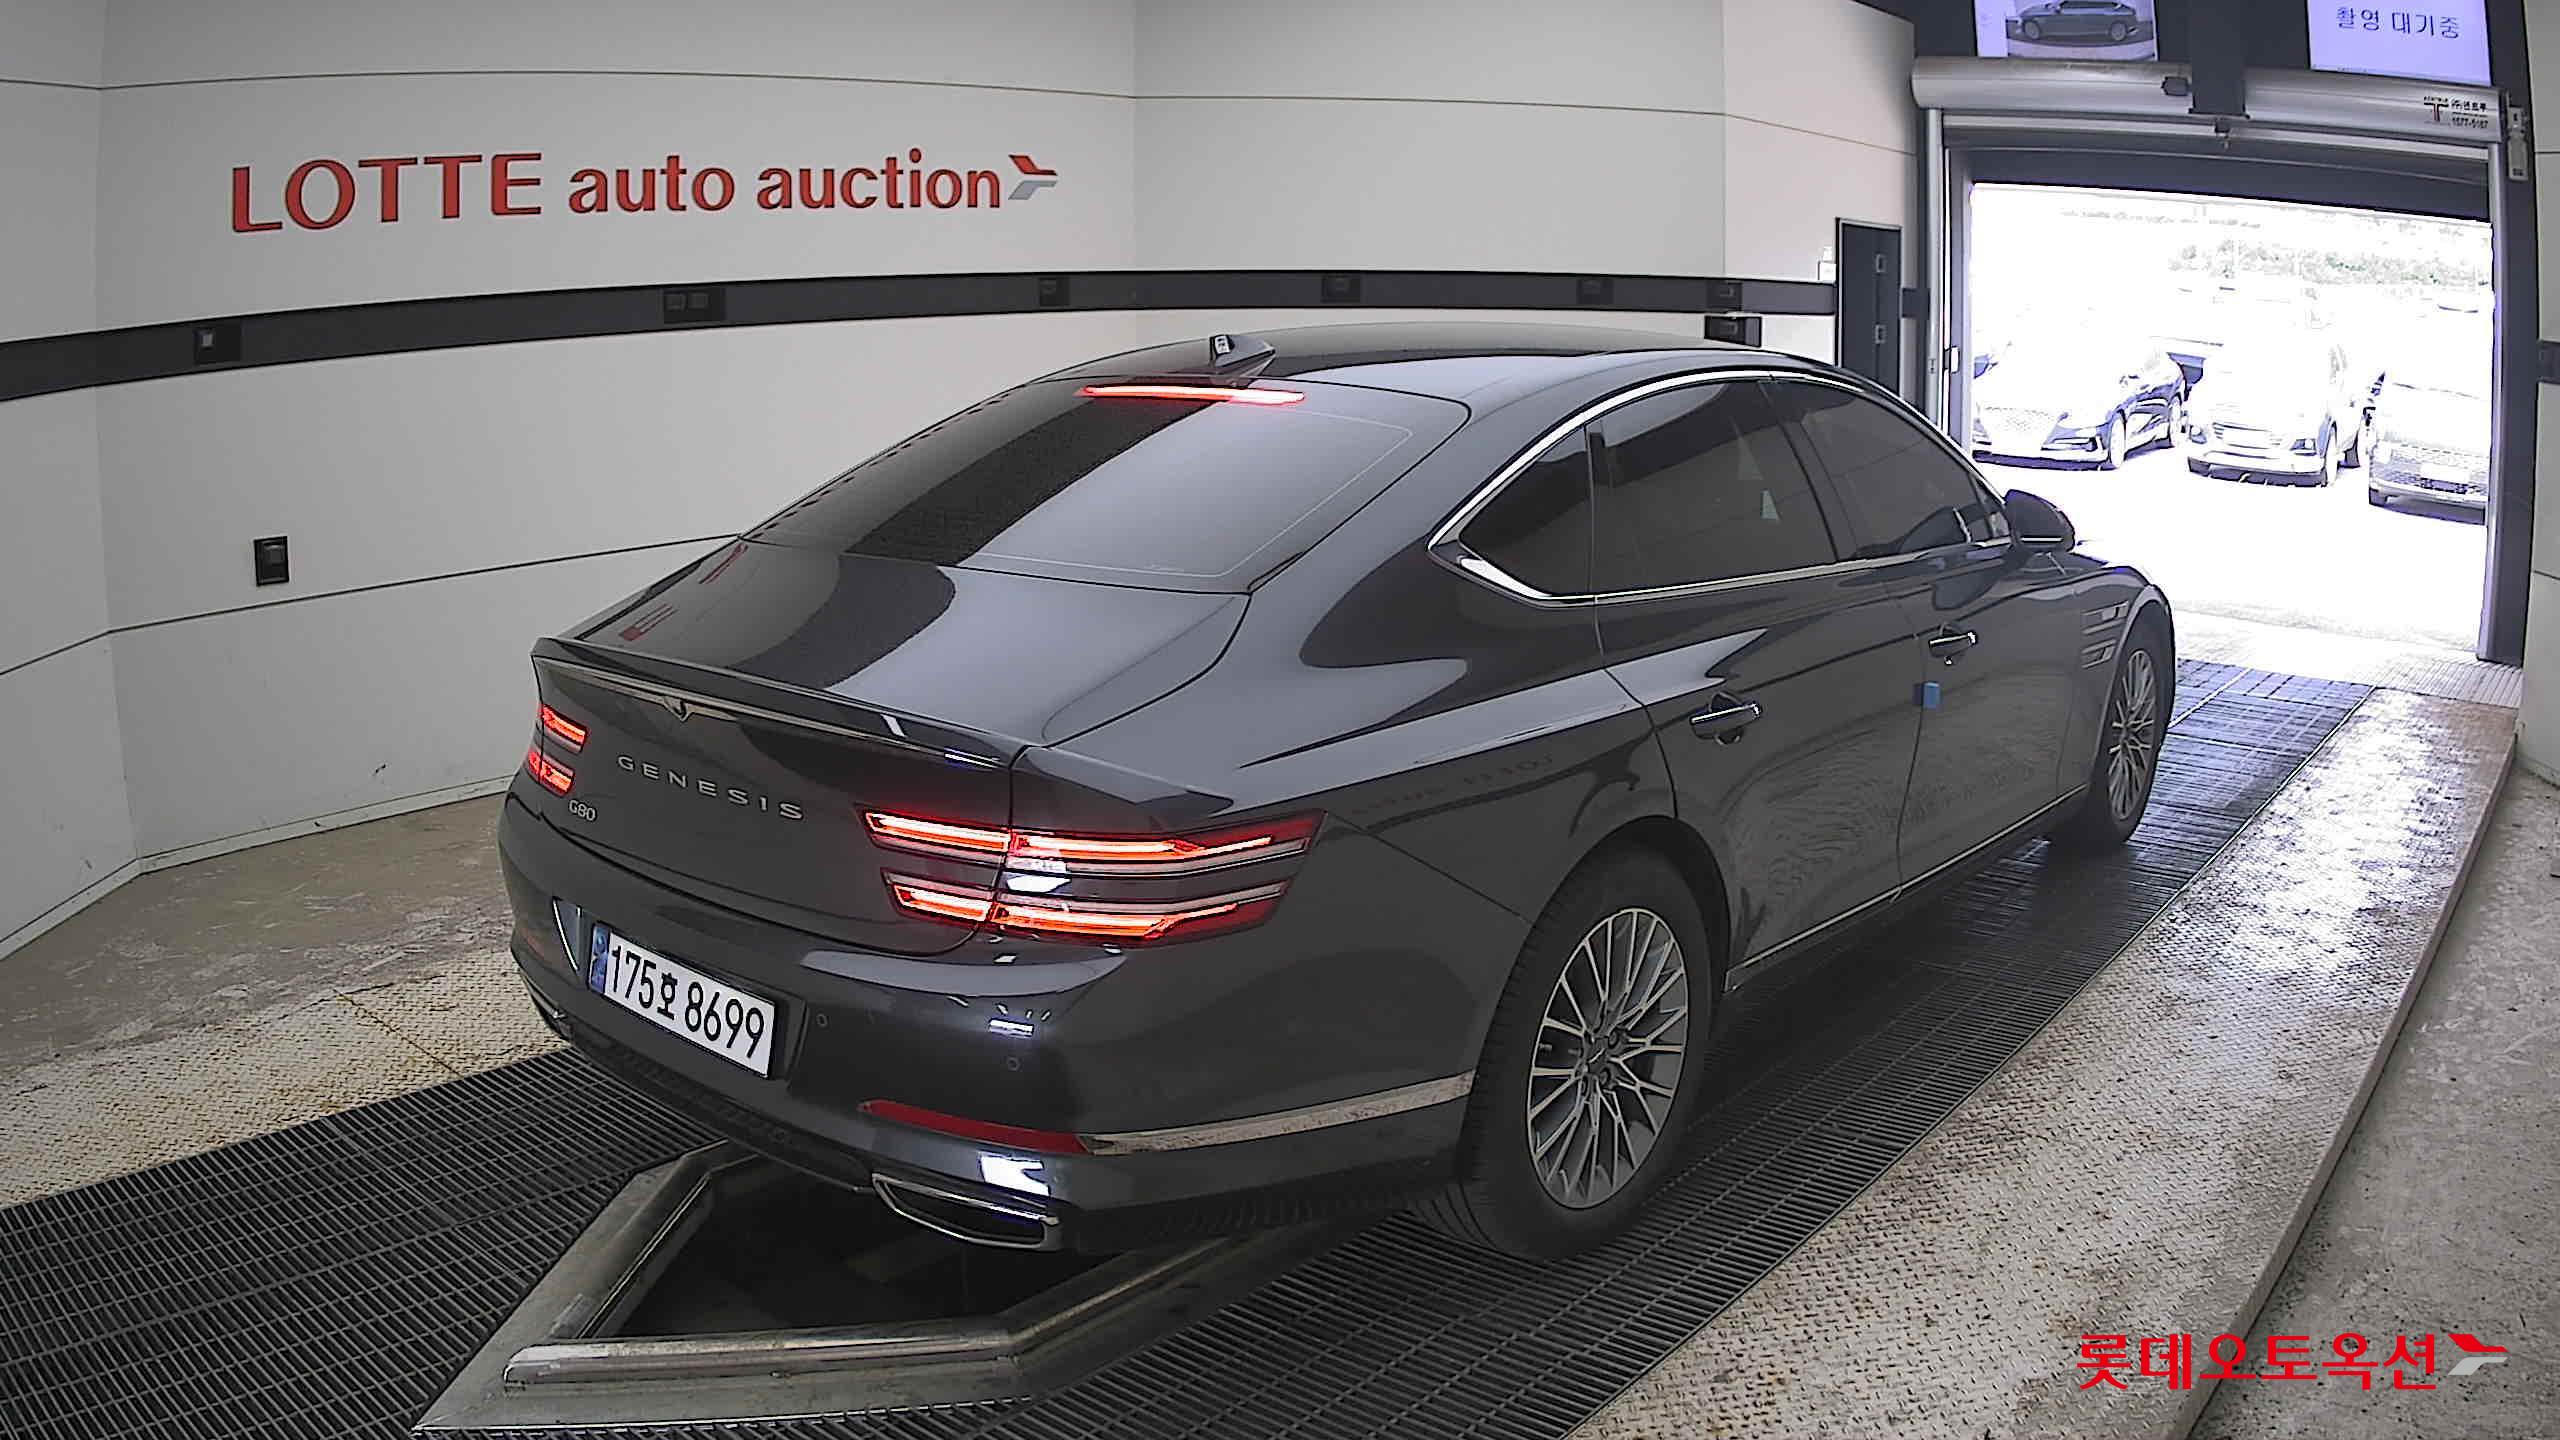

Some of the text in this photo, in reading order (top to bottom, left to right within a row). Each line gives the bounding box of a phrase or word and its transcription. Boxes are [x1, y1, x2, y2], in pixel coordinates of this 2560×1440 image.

[2336, 7, 2460, 39] 촬영 대기중
[232, 147, 1001, 233] LOTTE auto auction
[568, 799, 598, 823] G80
[616, 755, 804, 821] GENESIS
